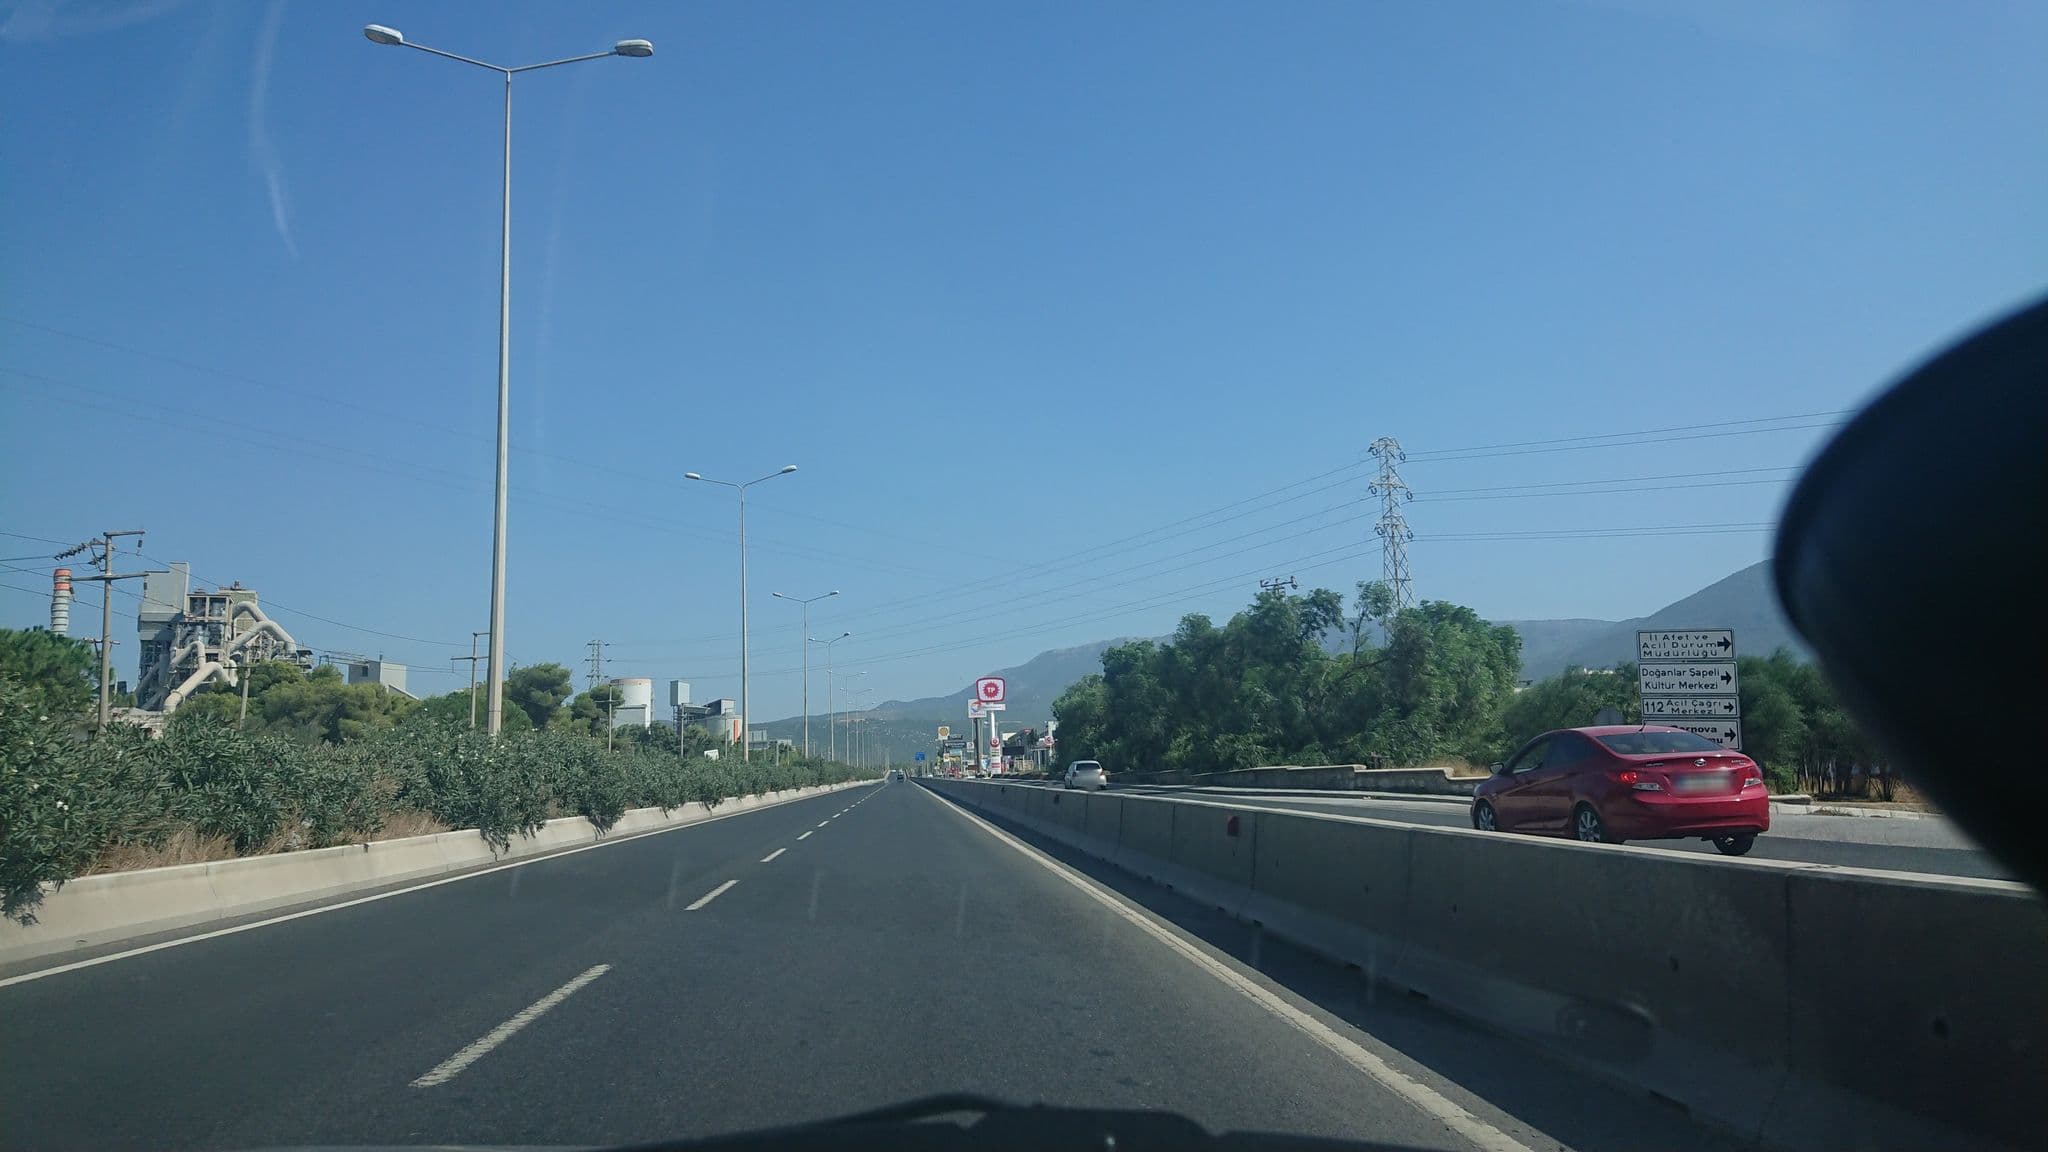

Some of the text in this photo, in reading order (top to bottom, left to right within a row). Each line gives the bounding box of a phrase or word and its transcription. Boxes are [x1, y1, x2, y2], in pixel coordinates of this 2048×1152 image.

[1643, 649, 1717, 659] Müdürlüğü
[1641, 668, 1686, 678] Doğanlar
[1645, 681, 1718, 690] Kültür Merkezi
[1645, 701, 1664, 713] 112
[1666, 699, 1688, 707] Acil
